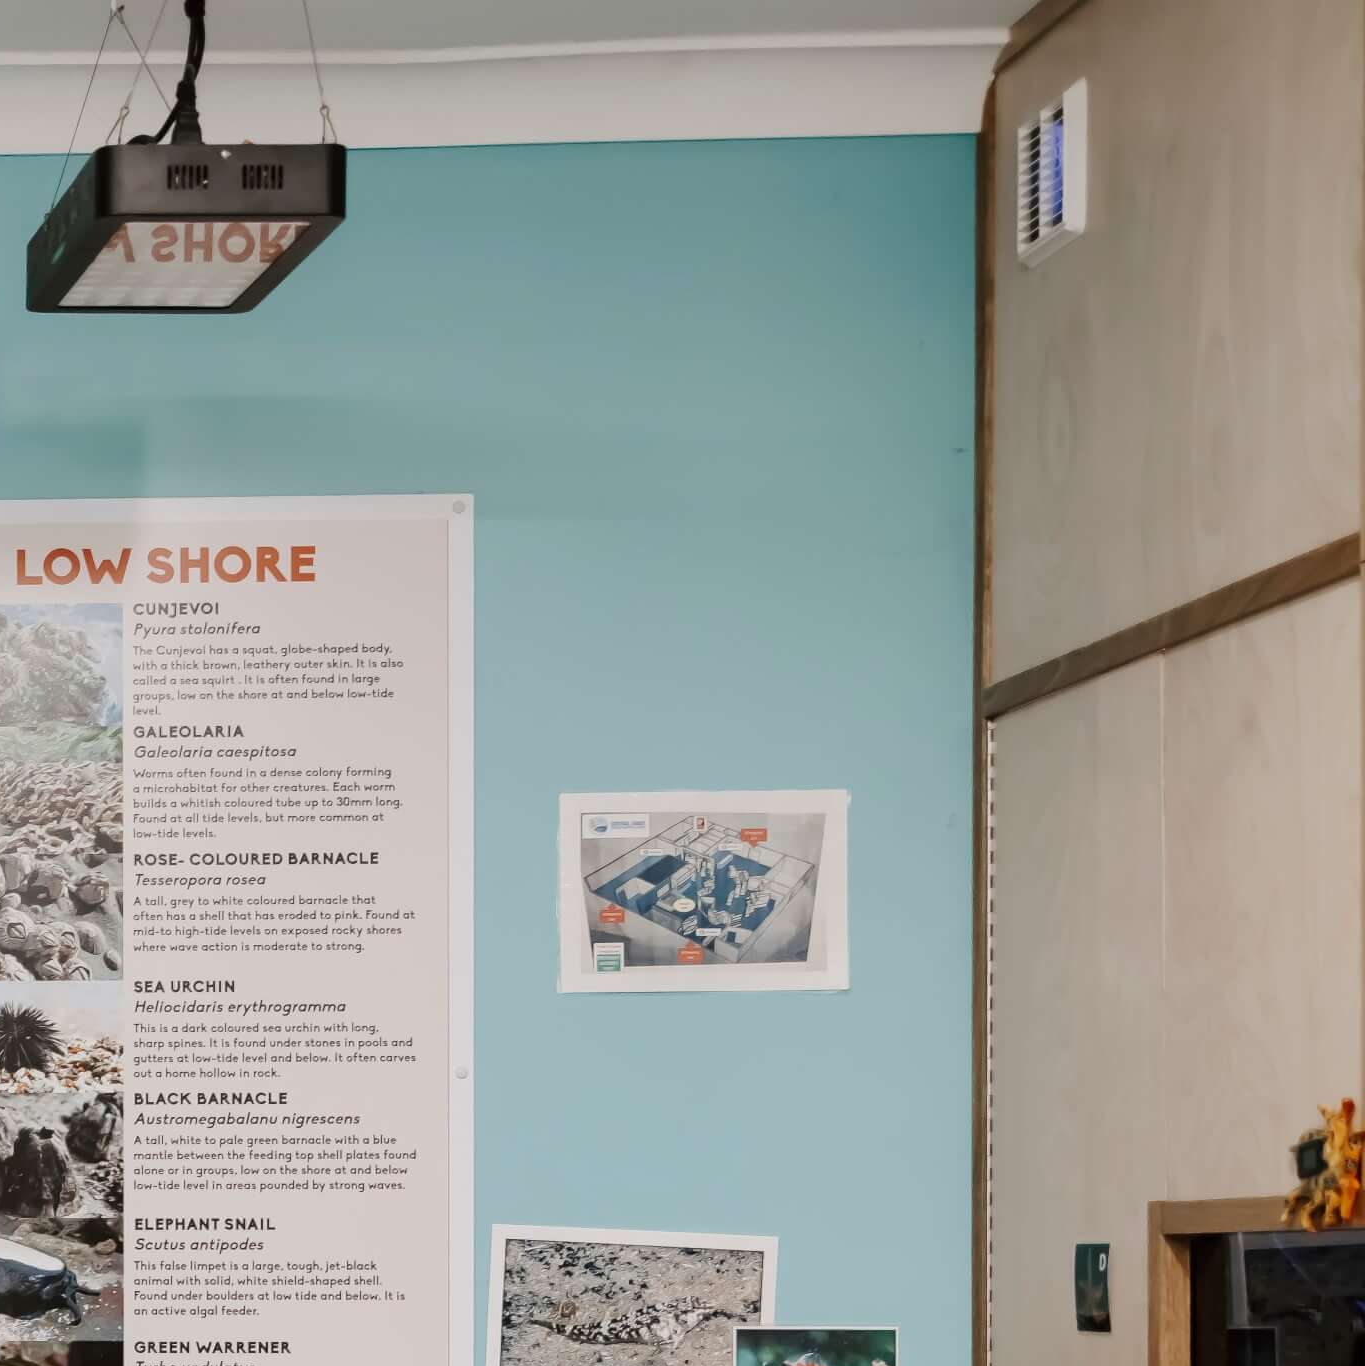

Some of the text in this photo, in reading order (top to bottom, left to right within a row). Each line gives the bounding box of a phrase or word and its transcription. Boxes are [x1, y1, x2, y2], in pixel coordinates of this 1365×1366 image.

[16, 545, 316, 586] LOW SHORE
[132, 601, 219, 619] CUNJEVOI
[133, 725, 245, 739] GALEOLARIA
[133, 851, 379, 866] ROSE- COLOURED BARNACLE
[133, 980, 235, 993] SEA URCHIN
[134, 1092, 288, 1105] BLACK BARNACLE
[134, 1217, 276, 1231] ELEPHANT SNAIL
[134, 1237, 264, 1254] Scutus antipodes
[133, 1305, 260, 1319] an active algal feeder.
[134, 1340, 291, 1354] GREEN WARRENER
